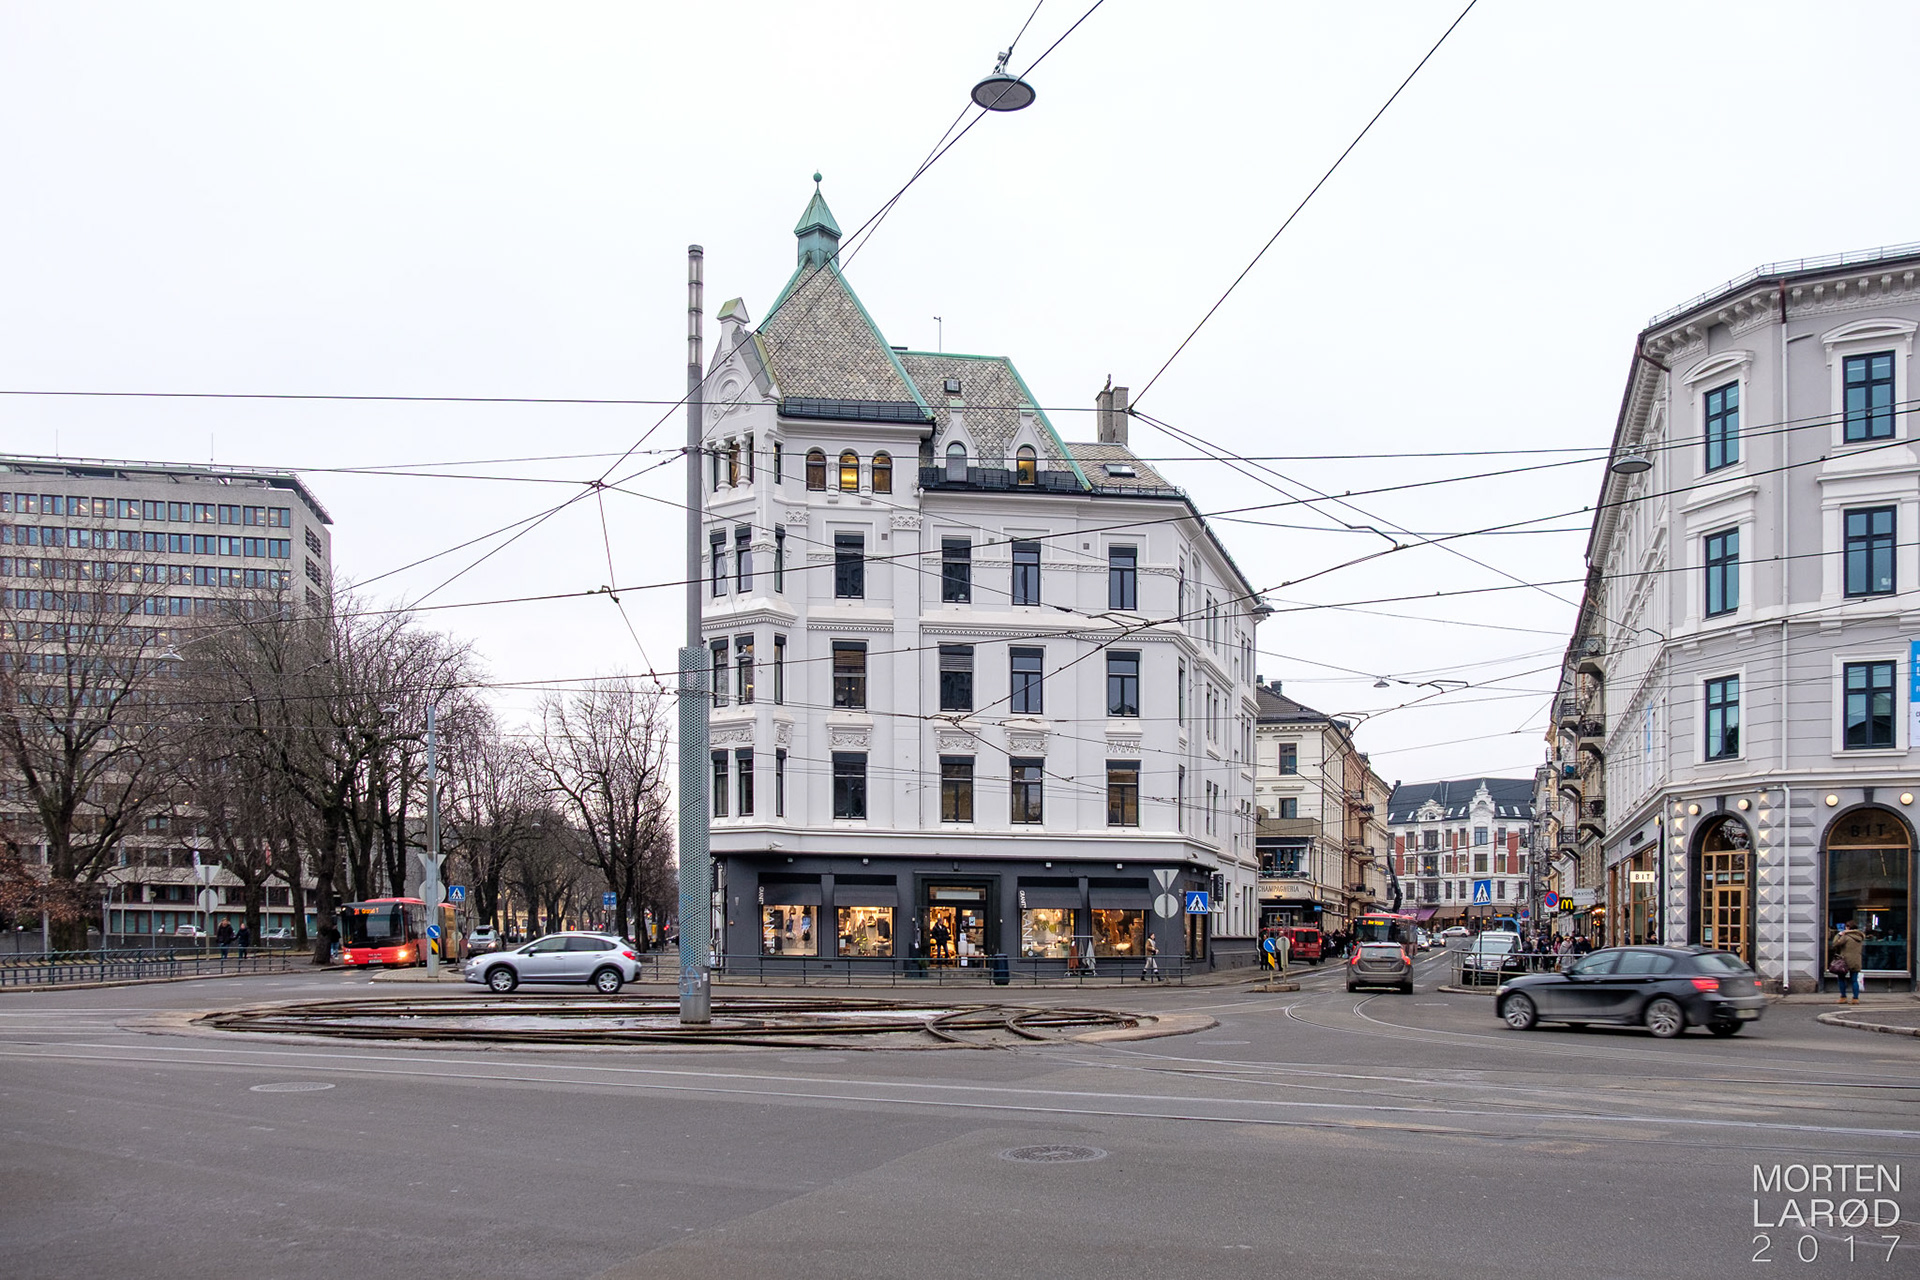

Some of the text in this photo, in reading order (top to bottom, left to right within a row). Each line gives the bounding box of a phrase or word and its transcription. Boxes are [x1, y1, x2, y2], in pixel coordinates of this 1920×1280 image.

[1851, 824, 1886, 837] BIT
[1635, 873, 1651, 881] BIT
[1257, 885, 1300, 893] CHAMPAGNERIA
